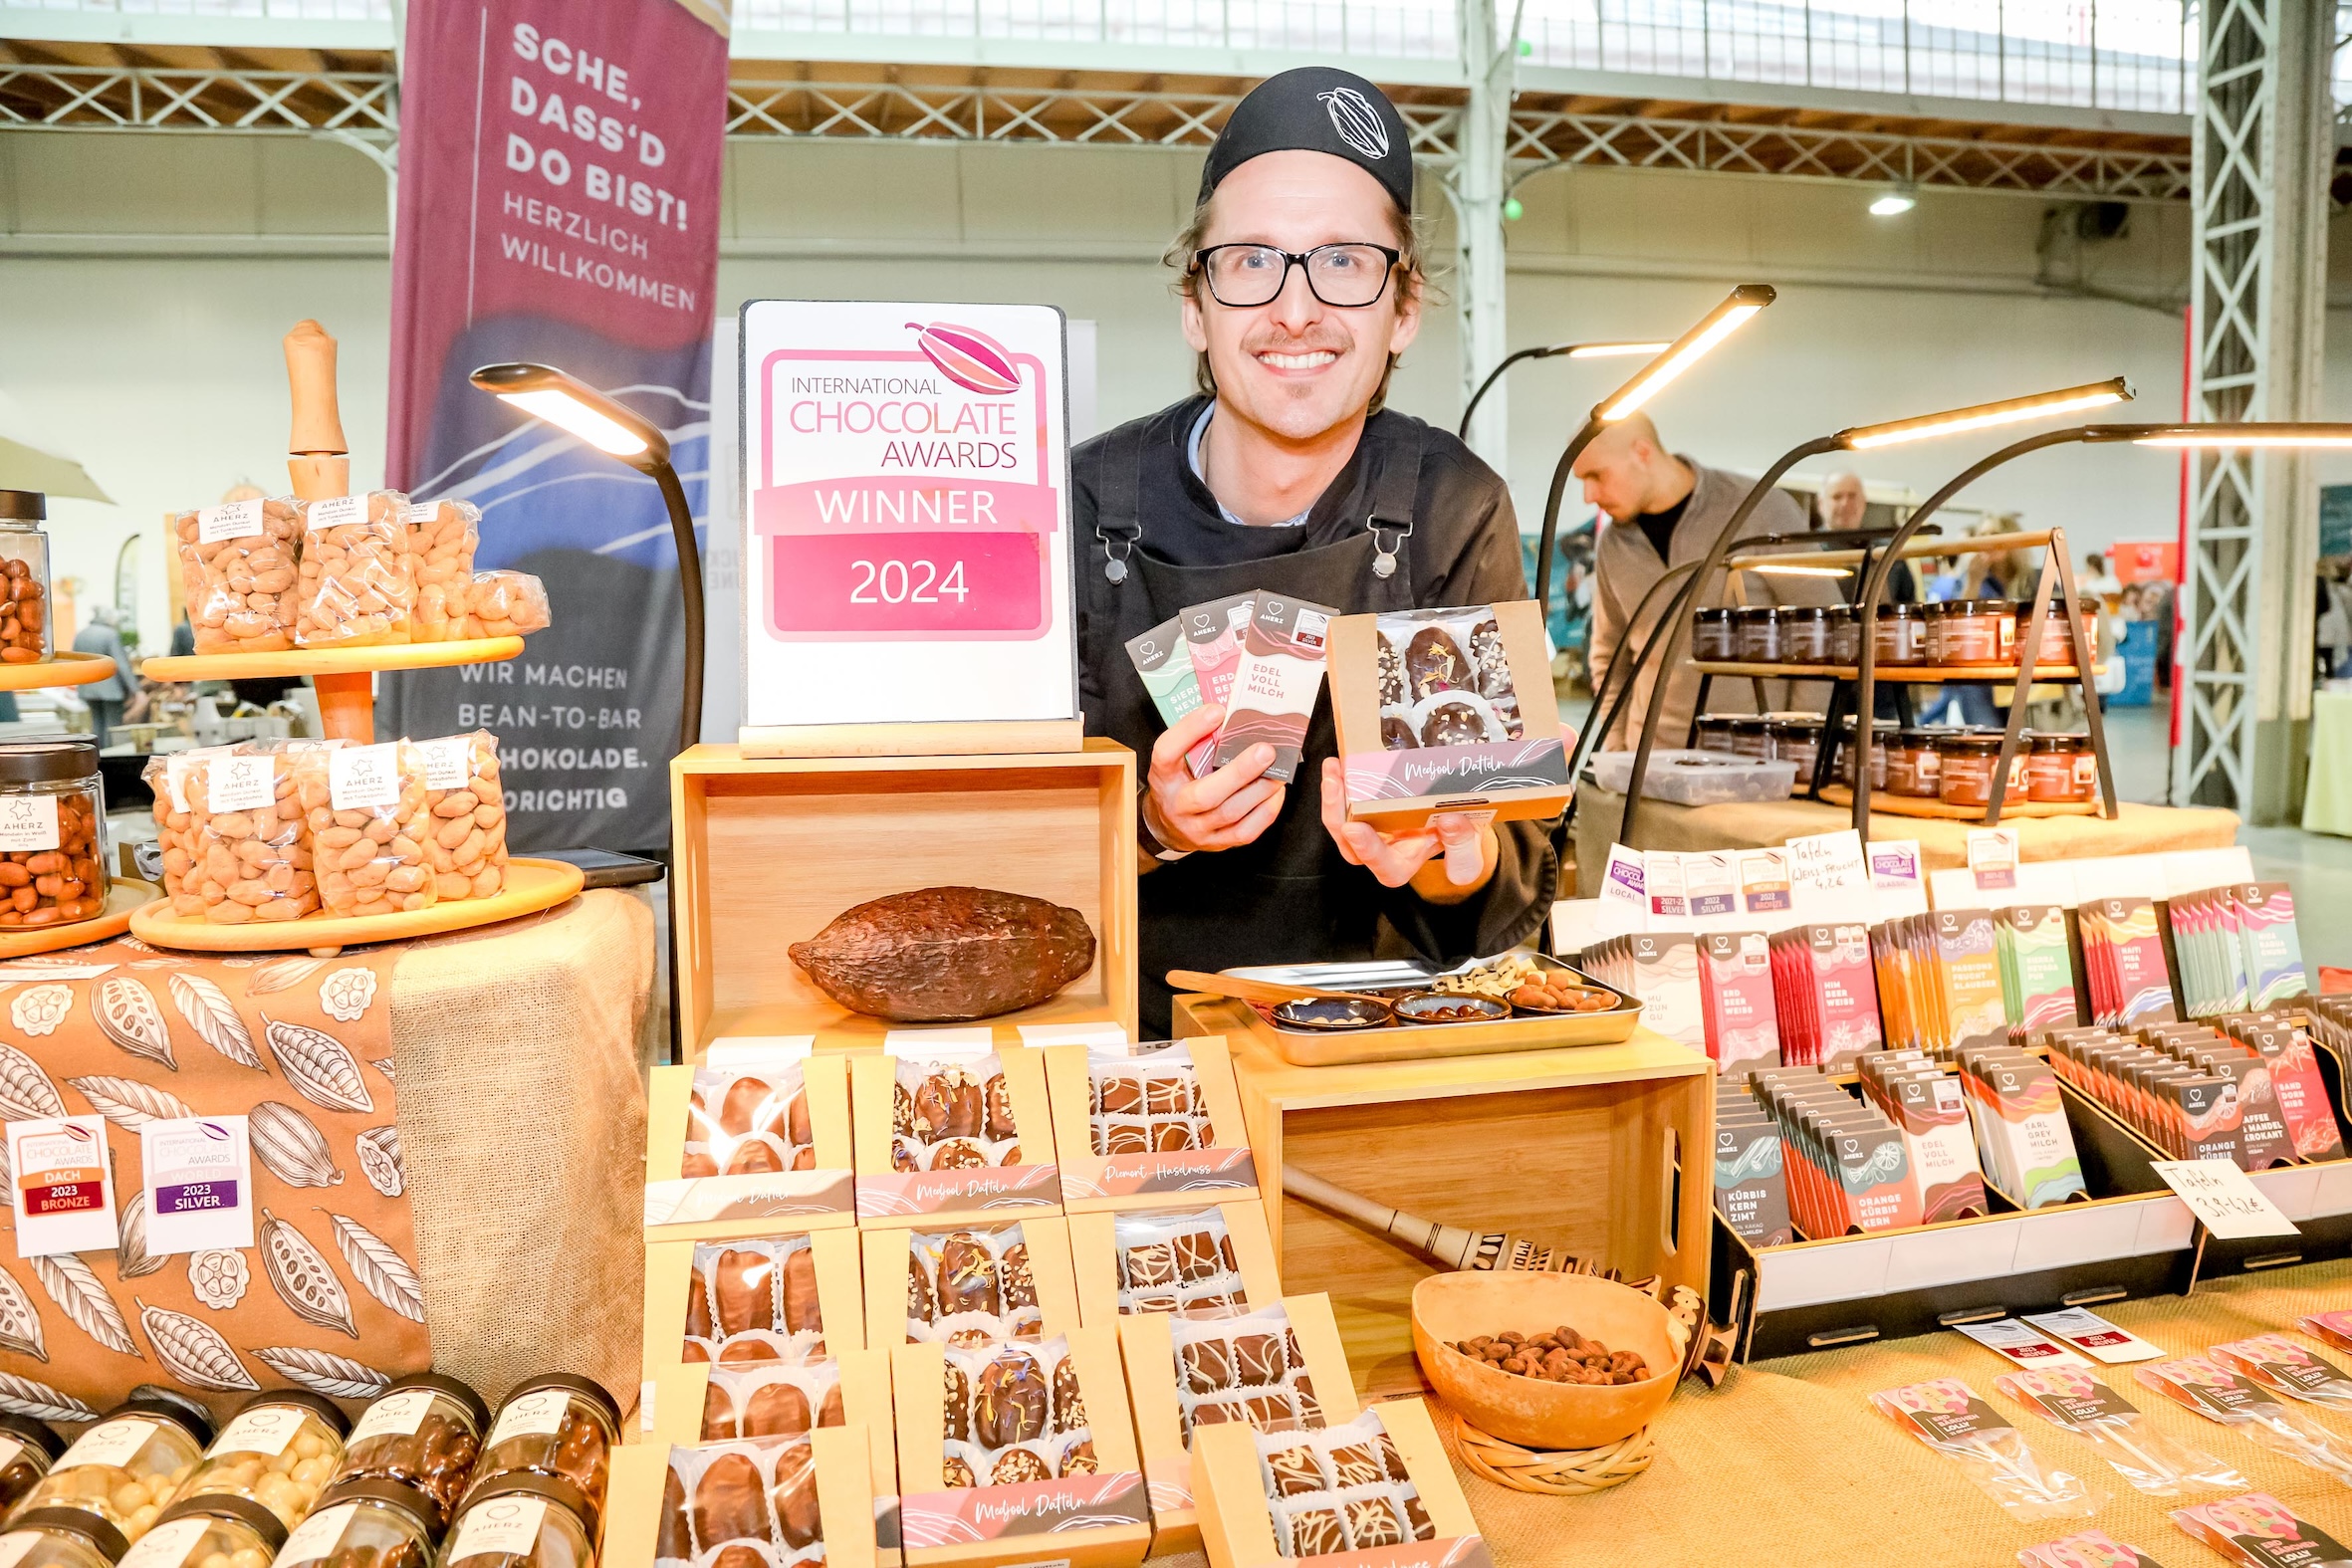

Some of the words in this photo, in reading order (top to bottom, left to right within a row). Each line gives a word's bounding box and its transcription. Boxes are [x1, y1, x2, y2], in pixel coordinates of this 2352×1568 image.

[514, 22, 641, 111] SCHE,
[507, 132, 572, 186] DO
[586, 163, 687, 231] BIST!
[504, 190, 647, 260] HERZLICH
[501, 233, 695, 312] WILLKOMMEN
[792, 377, 942, 395] INTERNATIONAL
[790, 401, 1017, 435] CHOCOLATE
[881, 441, 1017, 469] AWARDS
[322, 499, 354, 509] AHERZ
[815, 490, 998, 525] WINNER
[213, 513, 249, 524] AHERZ
[850, 560, 969, 603] 2024
[1260, 614, 1285, 624] AHERZ
[1193, 626, 1216, 637] AHERZ
[1142, 651, 1164, 665] AHERZ
[458, 662, 514, 684] WIR
[525, 665, 627, 690] MACHEN
[1254, 663, 1281, 677] EDEL
[1212, 672, 1235, 684] ERD
[1252, 674, 1280, 687] VOLL
[1248, 684, 1285, 699] MILCH
[458, 704, 641, 729] BEAN-TO-BAR
[501, 749, 647, 770] HOKOLADE.
[1405, 760, 1455, 782] Medjool
[1459, 755, 1506, 778] Datteln
[224, 780, 259, 789] AHERZ
[347, 777, 383, 786] AHERZ
[1792, 840, 1832, 860] Tafeln
[1610, 888, 1636, 901] LOCAL
[1704, 896, 1720, 905] 2022
[1701, 904, 1726, 914] SILVER
[1826, 998, 1854, 1007] WEISS
[1725, 1006, 1753, 1015] WEISS
[2242, 1113, 2269, 1124] AFFEE
[2025, 1121, 2048, 1130] EARL
[2248, 1121, 2283, 1132] MANDEL
[2027, 1130, 2051, 1139] GREY
[2030, 1139, 2058, 1148] MILCH
[2199, 1141, 2235, 1153] ORANGE
[27, 1145, 94, 1160] CHOCOLATE
[54, 1156, 94, 1167] AWARDS
[188, 1154, 231, 1166] AWARDS
[1926, 1159, 1955, 1168] MILCH
[45, 1170, 81, 1183] DACH
[171, 1169, 222, 1183] WORLD
[2164, 1166, 2224, 1192] Tafeln
[51, 1185, 79, 1198] 2023
[182, 1184, 211, 1197] 2023
[917, 1183, 963, 1202] Medjool
[967, 1179, 1010, 1198] Datteln
[1728, 1190, 1766, 1202] KÜRBIS
[41, 1197, 91, 1212] BRONZE
[174, 1196, 221, 1211] SILVER
[1729, 1201, 1758, 1212] KERN
[1859, 1194, 1901, 1207] ORANGE
[1731, 1212, 1756, 1223] ZIMT
[1860, 1204, 1898, 1218] KÜRBIS
[1863, 1217, 1890, 1228] KERN
[367, 1410, 411, 1424] AHERZ
[506, 1410, 552, 1424] AHERZ
[2071, 1406, 2098, 1416] LOLLY
[1944, 1421, 1971, 1432] LOLLY
[975, 1497, 1032, 1524] Medjool
[1035, 1491, 1086, 1517] Datteln
[471, 1522, 524, 1534] AHERZ
[2260, 1539, 2283, 1548] ERD
[2279, 1549, 2312, 1563] LOLLY
